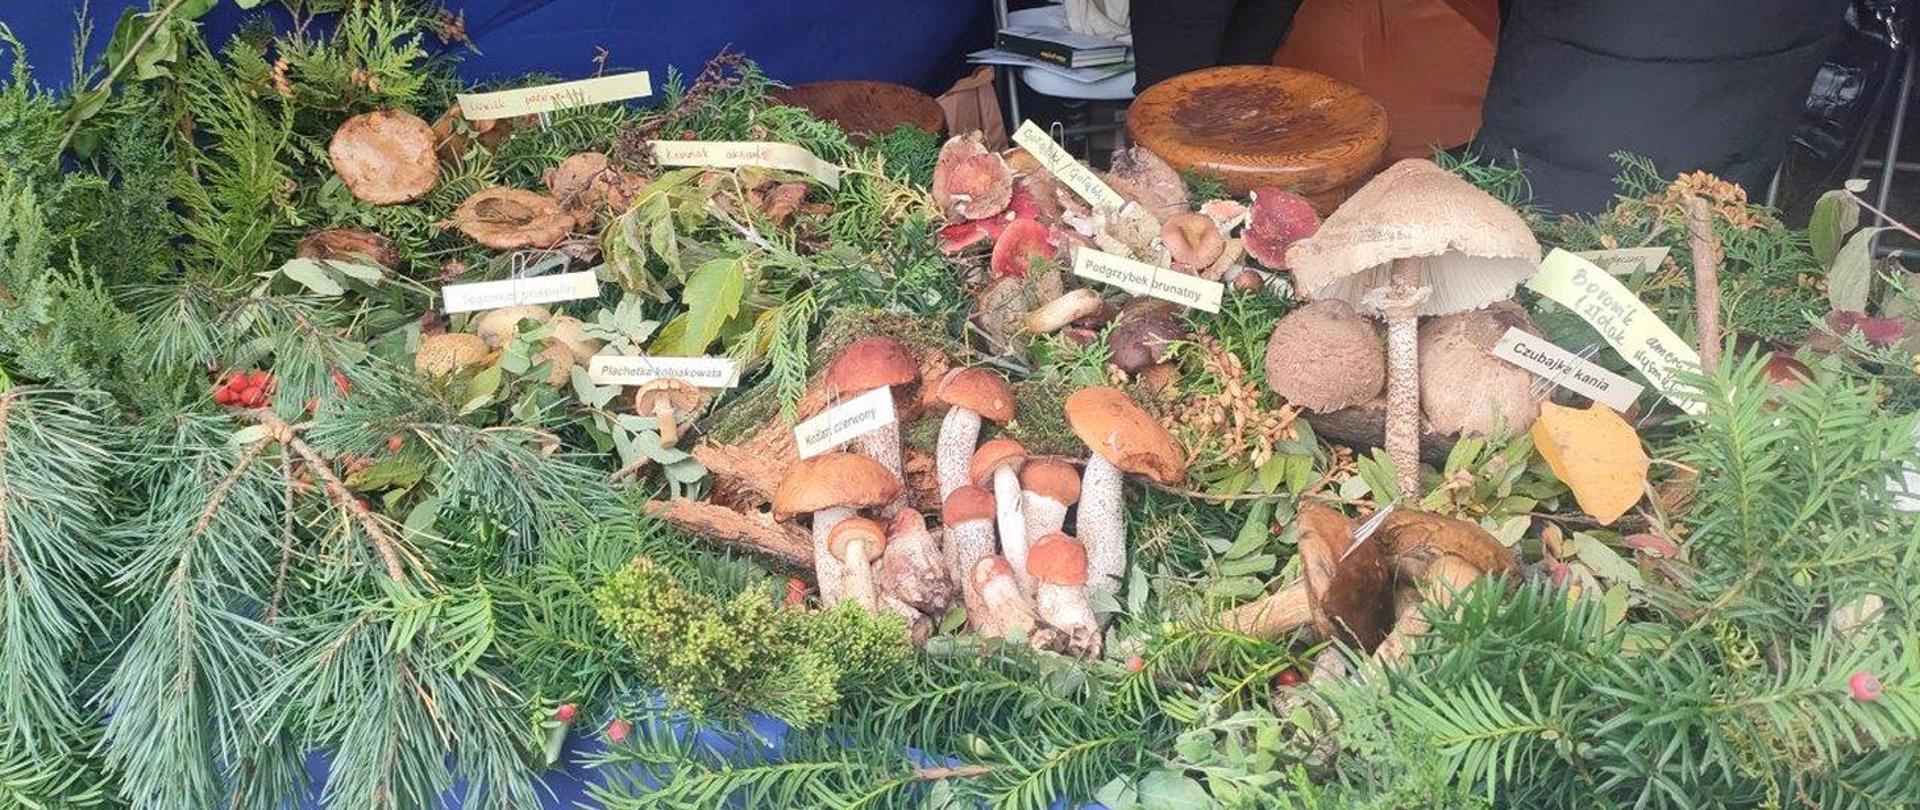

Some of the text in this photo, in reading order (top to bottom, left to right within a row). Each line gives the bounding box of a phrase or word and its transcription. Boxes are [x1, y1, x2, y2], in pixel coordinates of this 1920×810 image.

[1084, 259, 1202, 302] Podgrzybek brunatny
[1512, 341, 1610, 393] Czubajka kania
[833, 407, 877, 434] czerwony
